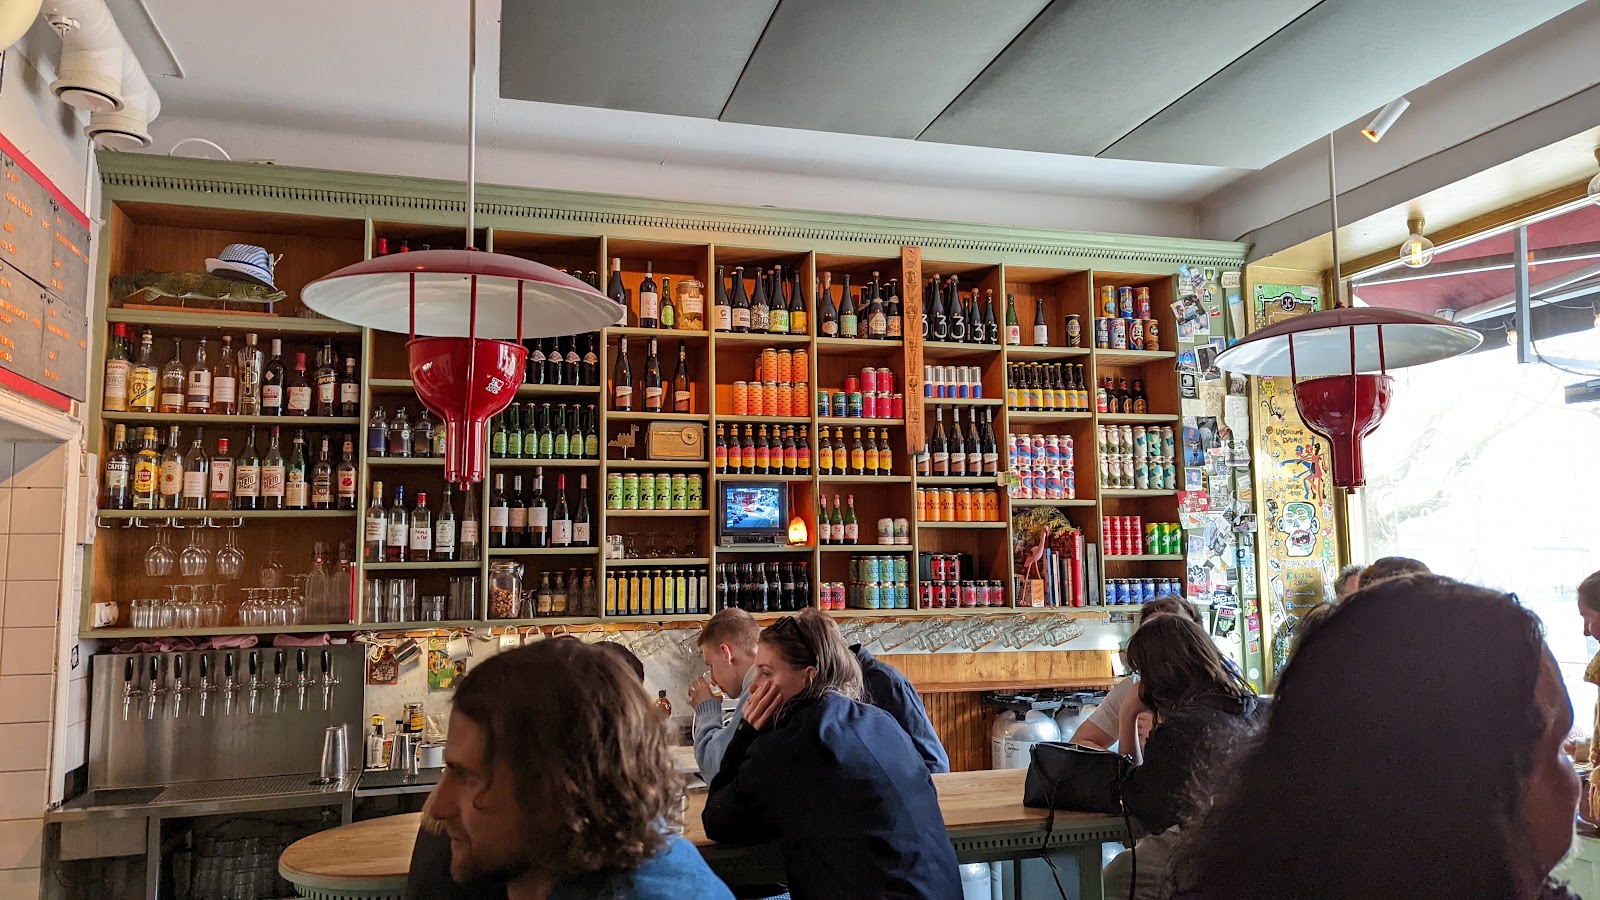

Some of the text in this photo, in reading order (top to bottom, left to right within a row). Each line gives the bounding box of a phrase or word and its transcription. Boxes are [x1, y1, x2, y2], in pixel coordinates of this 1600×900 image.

[934, 315, 947, 338] 3
[951, 316, 965, 339] 3
[975, 323, 983, 341] 3
[990, 323, 998, 341] 3
